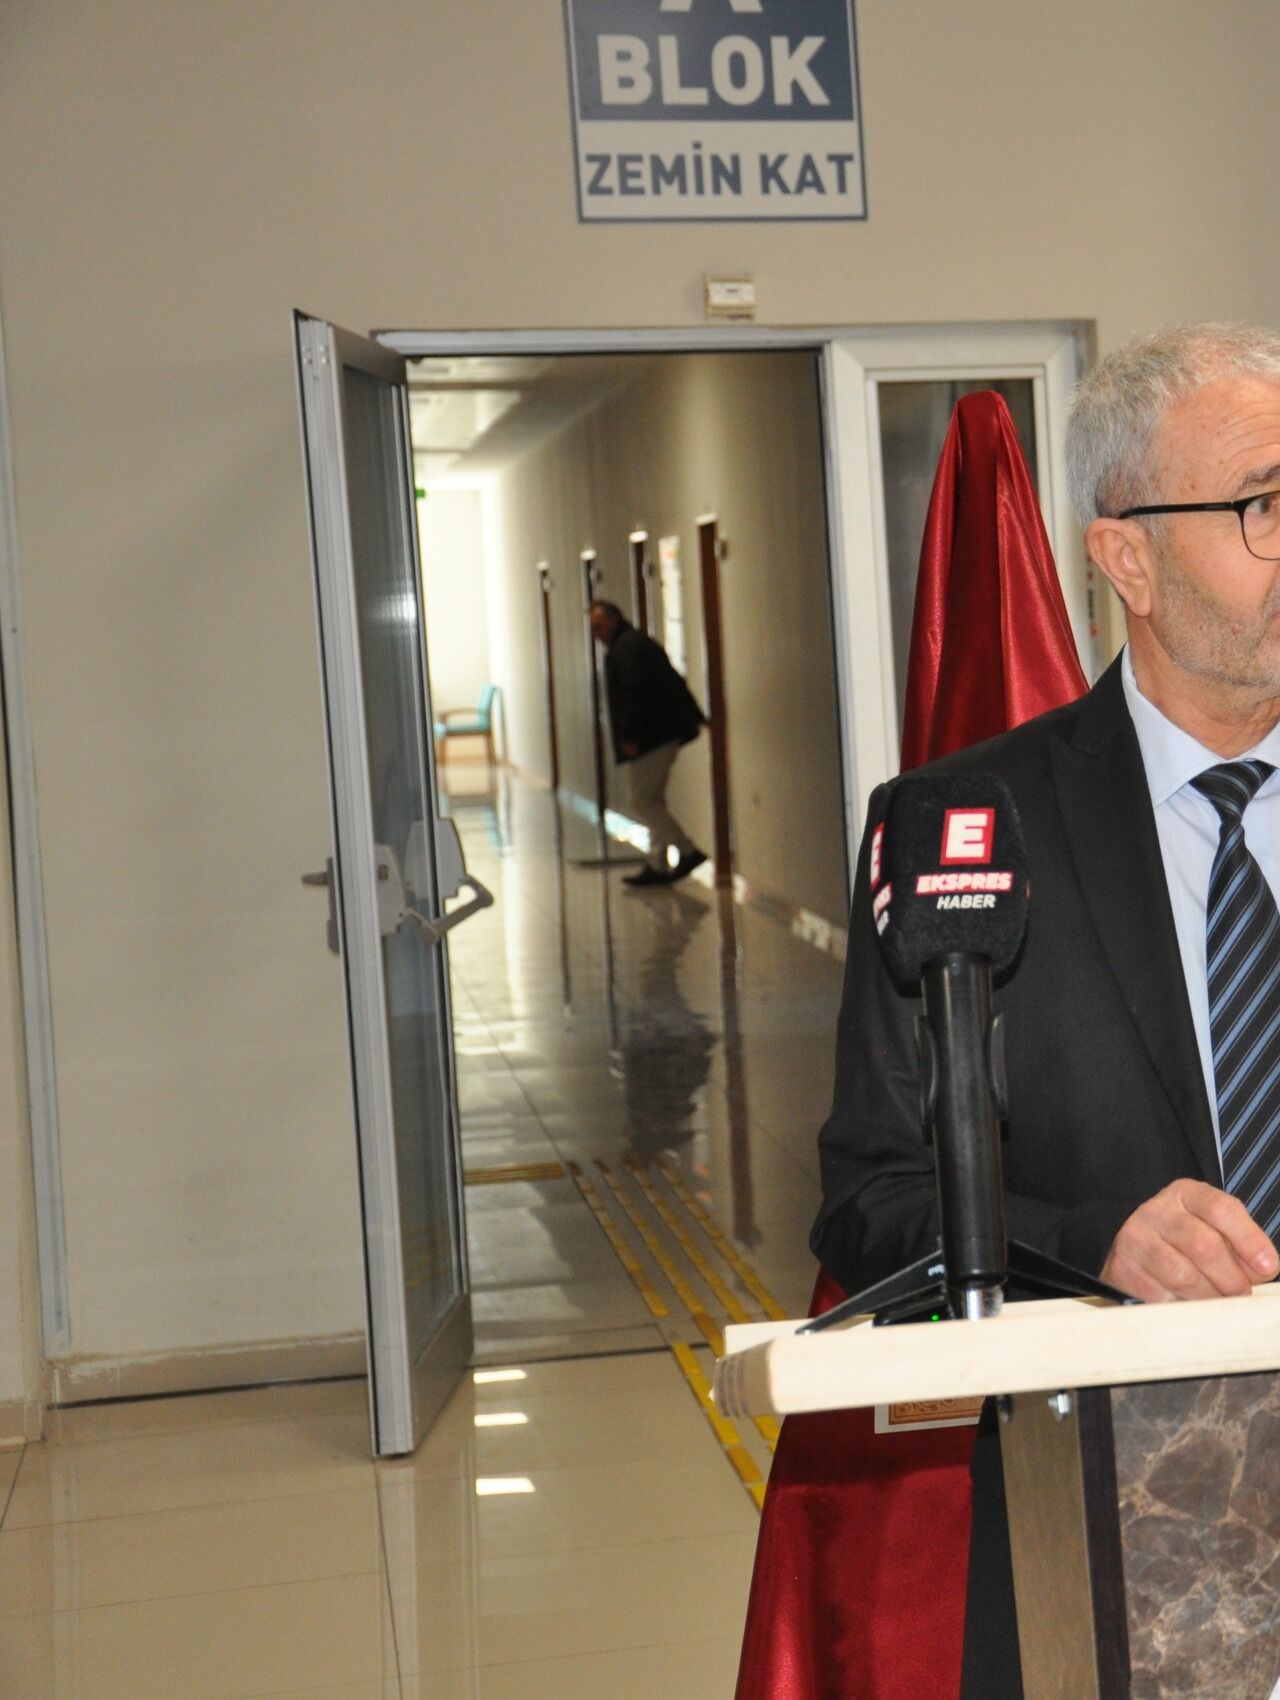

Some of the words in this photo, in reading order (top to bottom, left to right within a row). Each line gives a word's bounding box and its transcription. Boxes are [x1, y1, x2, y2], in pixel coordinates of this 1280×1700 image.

[597, 34, 830, 106] BLOK
[586, 141, 742, 195] ZEMİN
[759, 154, 853, 195] KAT
[946, 813, 987, 858] E
[916, 872, 1012, 894] EKSPRES
[936, 894, 996, 910] HABER
